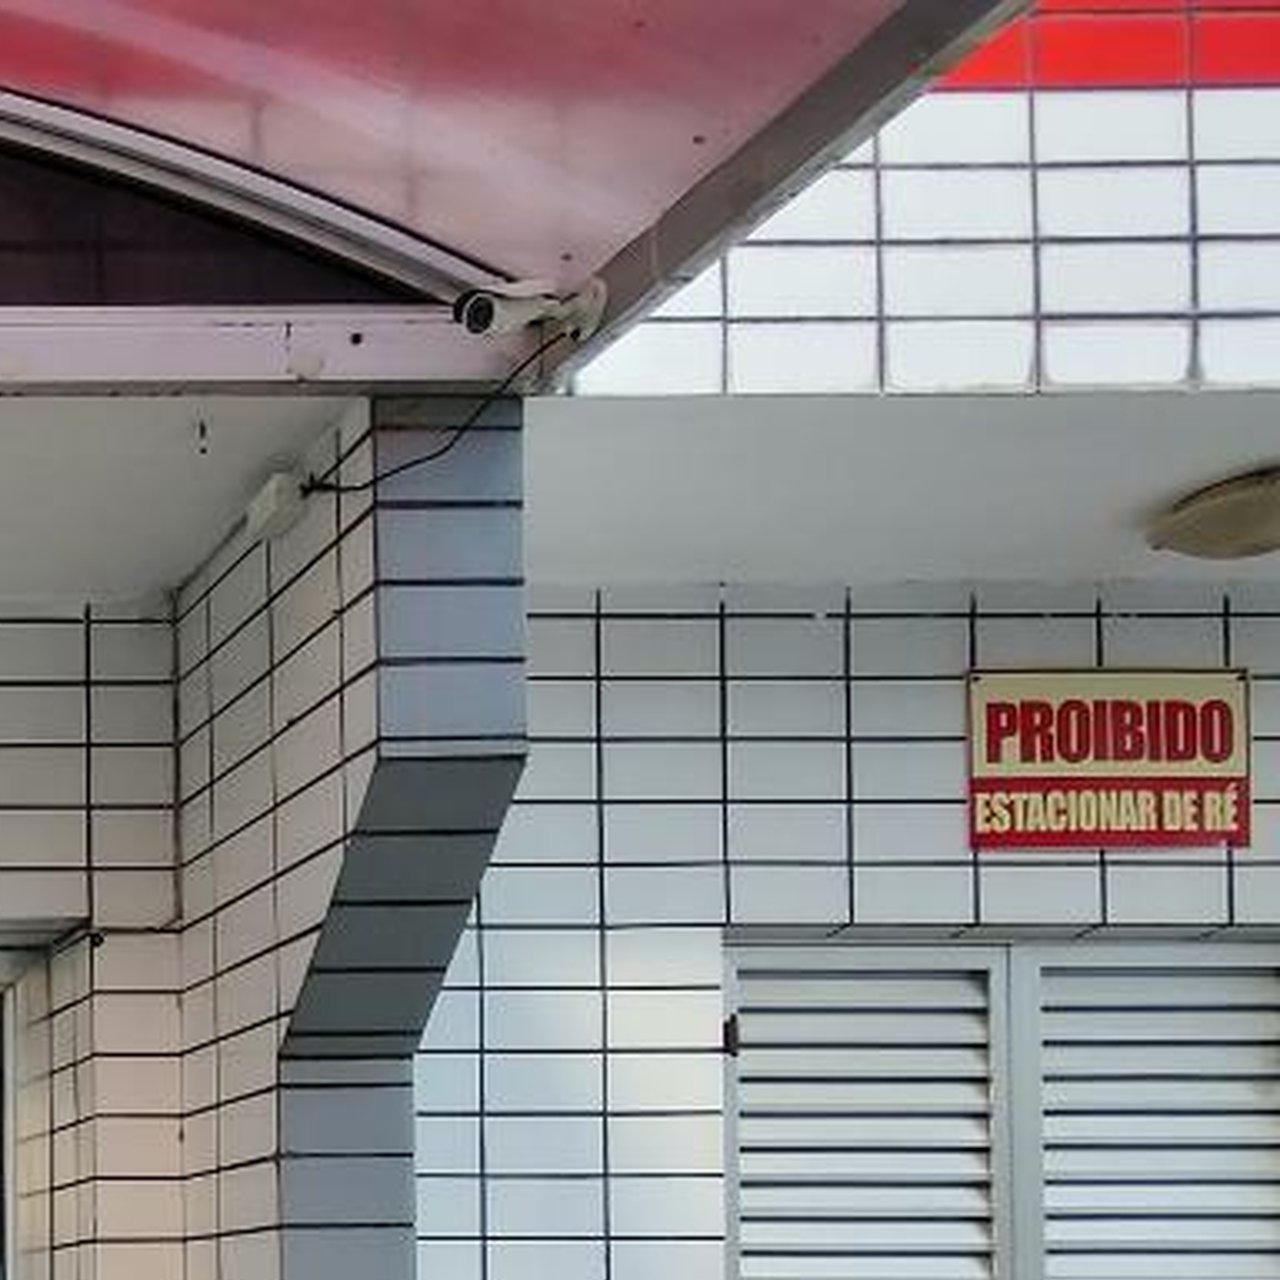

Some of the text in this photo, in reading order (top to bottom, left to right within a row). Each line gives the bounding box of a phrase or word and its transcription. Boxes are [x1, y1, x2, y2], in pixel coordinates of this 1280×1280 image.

[985, 699, 1234, 763] PROIBIDO
[974, 783, 1238, 833] ESTACIONAR DE RÉ
